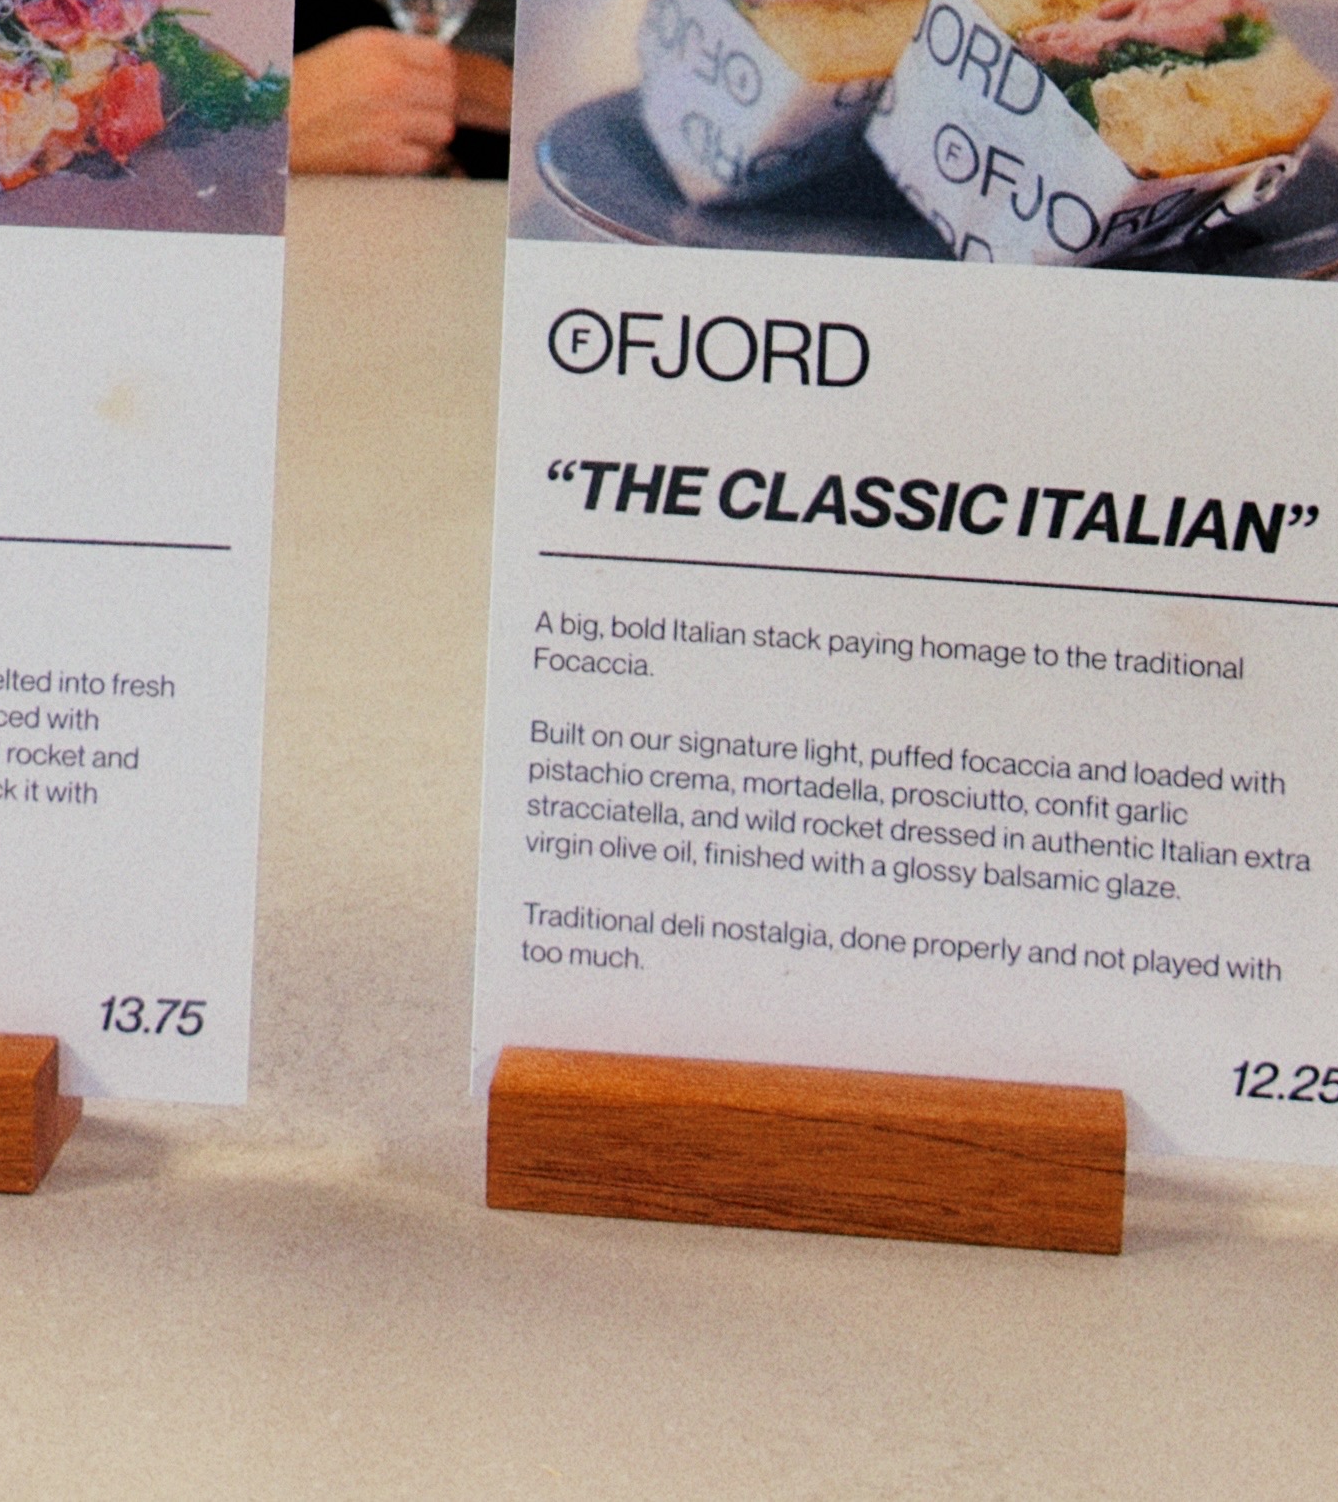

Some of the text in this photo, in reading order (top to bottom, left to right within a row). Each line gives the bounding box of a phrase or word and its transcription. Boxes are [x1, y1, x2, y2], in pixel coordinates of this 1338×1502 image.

[618, 312, 872, 389] FJORD
[547, 459, 1320, 554] “THE CLASSIC ITALIAN”
[533, 646, 653, 677] Focaccia.
[534, 610, 1244, 680] A big, bold Italian stack paying homage to the traditional
[46, 708, 99, 731] with
[58, 672, 106, 696] into
[112, 673, 175, 698] fresh
[530, 719, 1286, 795] Built on our signature light, puffed focaccia and loaded with
[528, 758, 1188, 827] pistachio crema, mortadella, prosciutto, confit garlic
[101, 996, 207, 1037] 13.75
